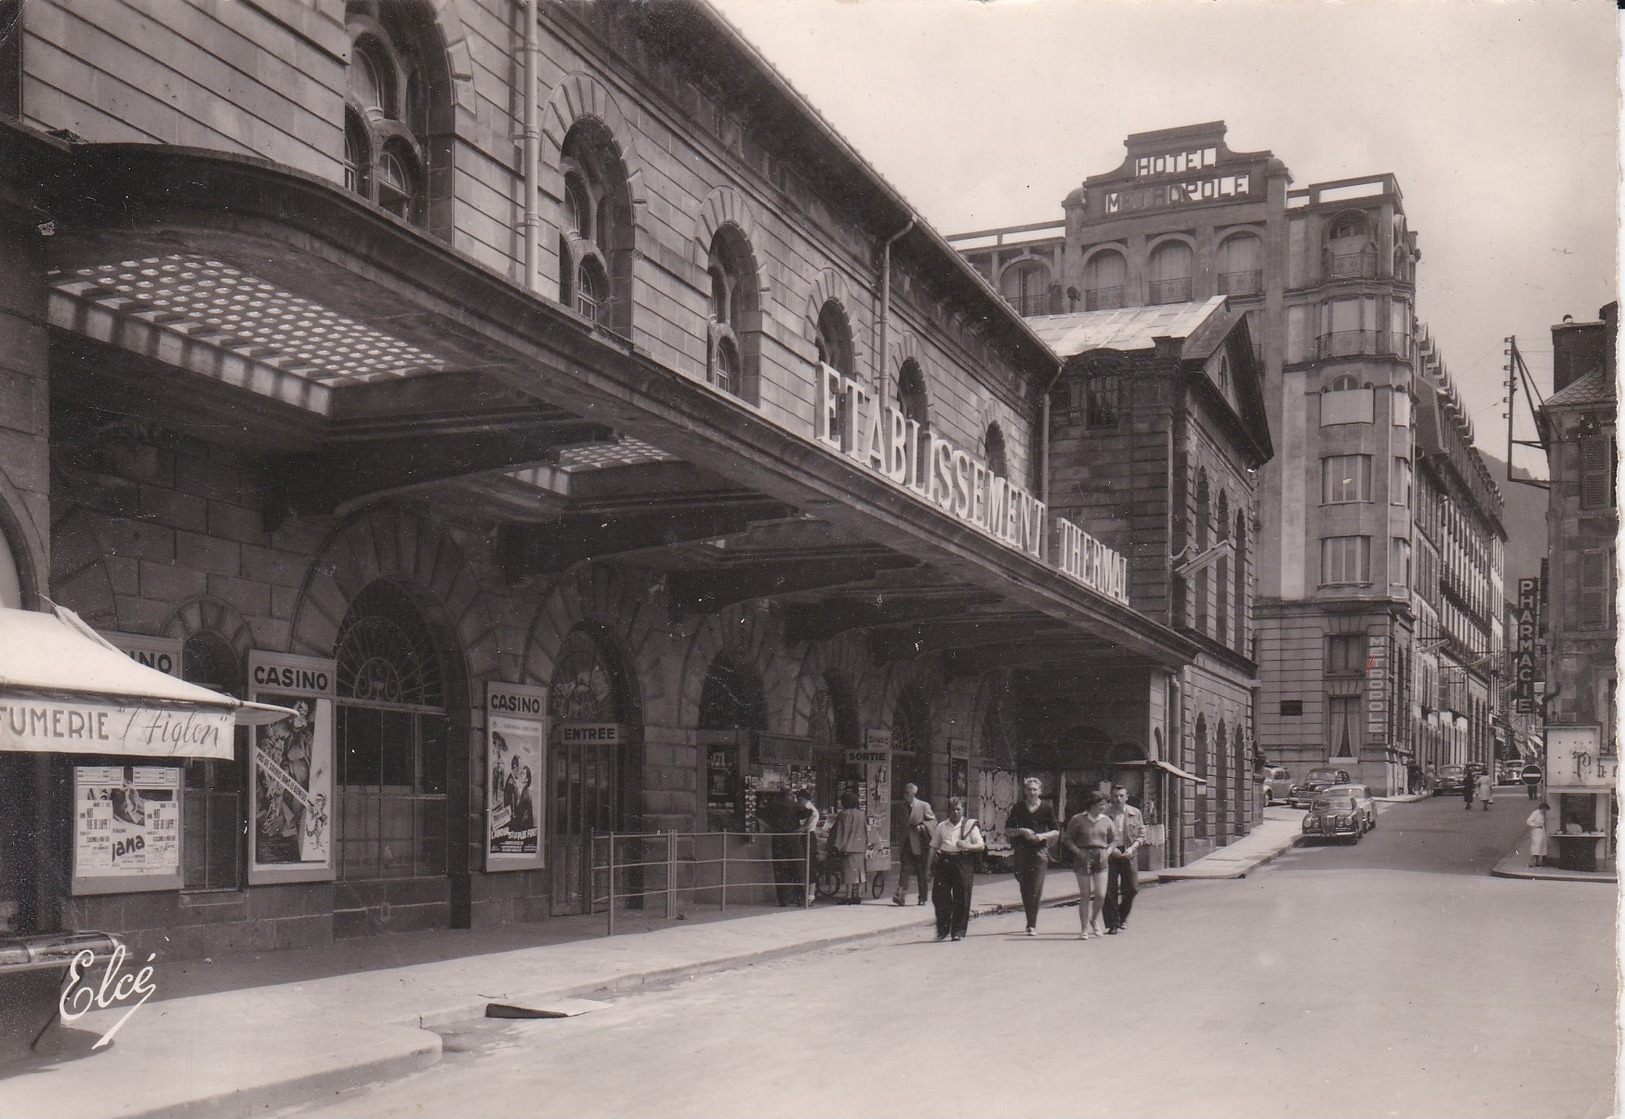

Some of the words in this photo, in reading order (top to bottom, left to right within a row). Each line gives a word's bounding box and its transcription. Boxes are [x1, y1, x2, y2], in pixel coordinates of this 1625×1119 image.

[1135, 148, 1216, 177] HOTEL
[814, 361, 1046, 558] ETABLISSEMENT
[1057, 517, 1129, 606] THERMAL
[1518, 579, 1534, 712] PHARMACIE
[130, 652, 173, 674] INO
[254, 665, 329, 691] CASINO
[1368, 636, 1385, 733] METROPOLE
[490, 693, 540, 714] CASINO
[849, 752, 886, 762] SORTIE
